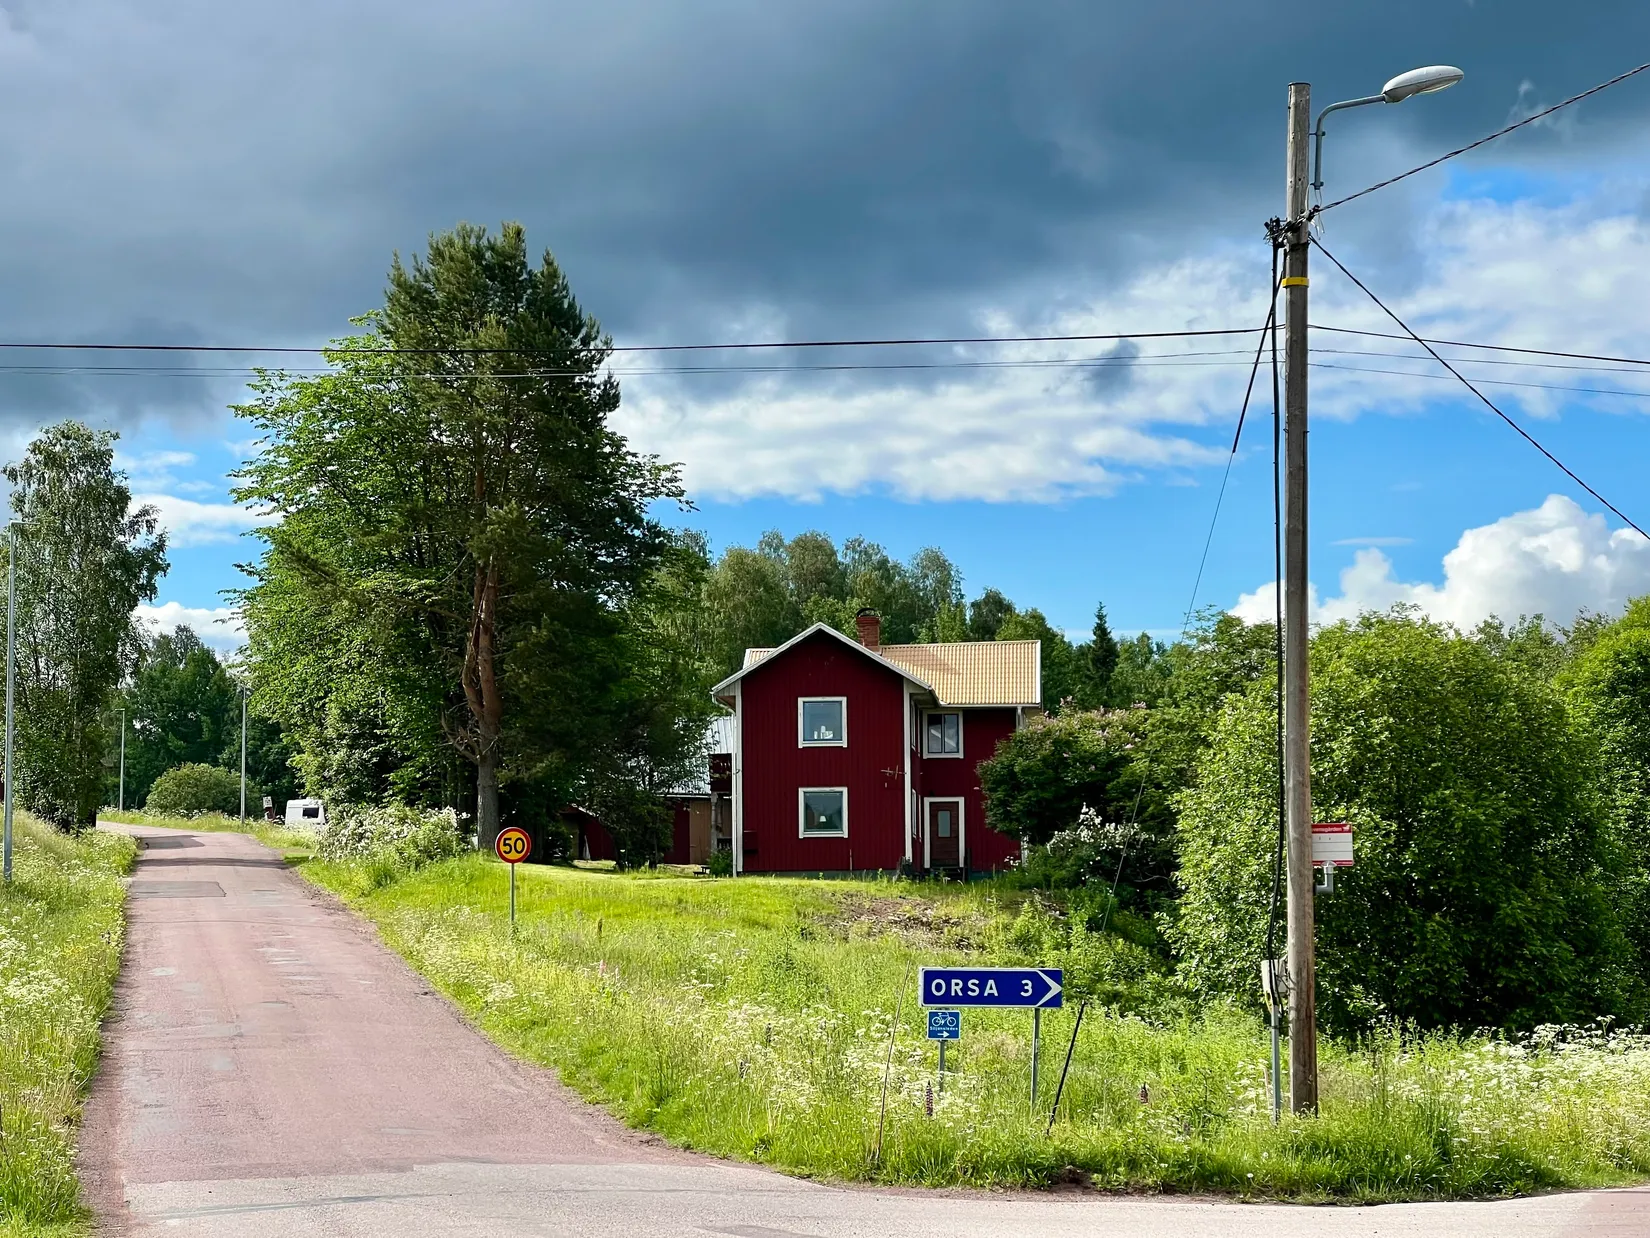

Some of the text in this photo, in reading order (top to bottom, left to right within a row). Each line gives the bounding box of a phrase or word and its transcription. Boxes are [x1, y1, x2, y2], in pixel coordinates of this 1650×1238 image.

[503, 837, 525, 854] 50
[931, 979, 1033, 997] ORSA 3
